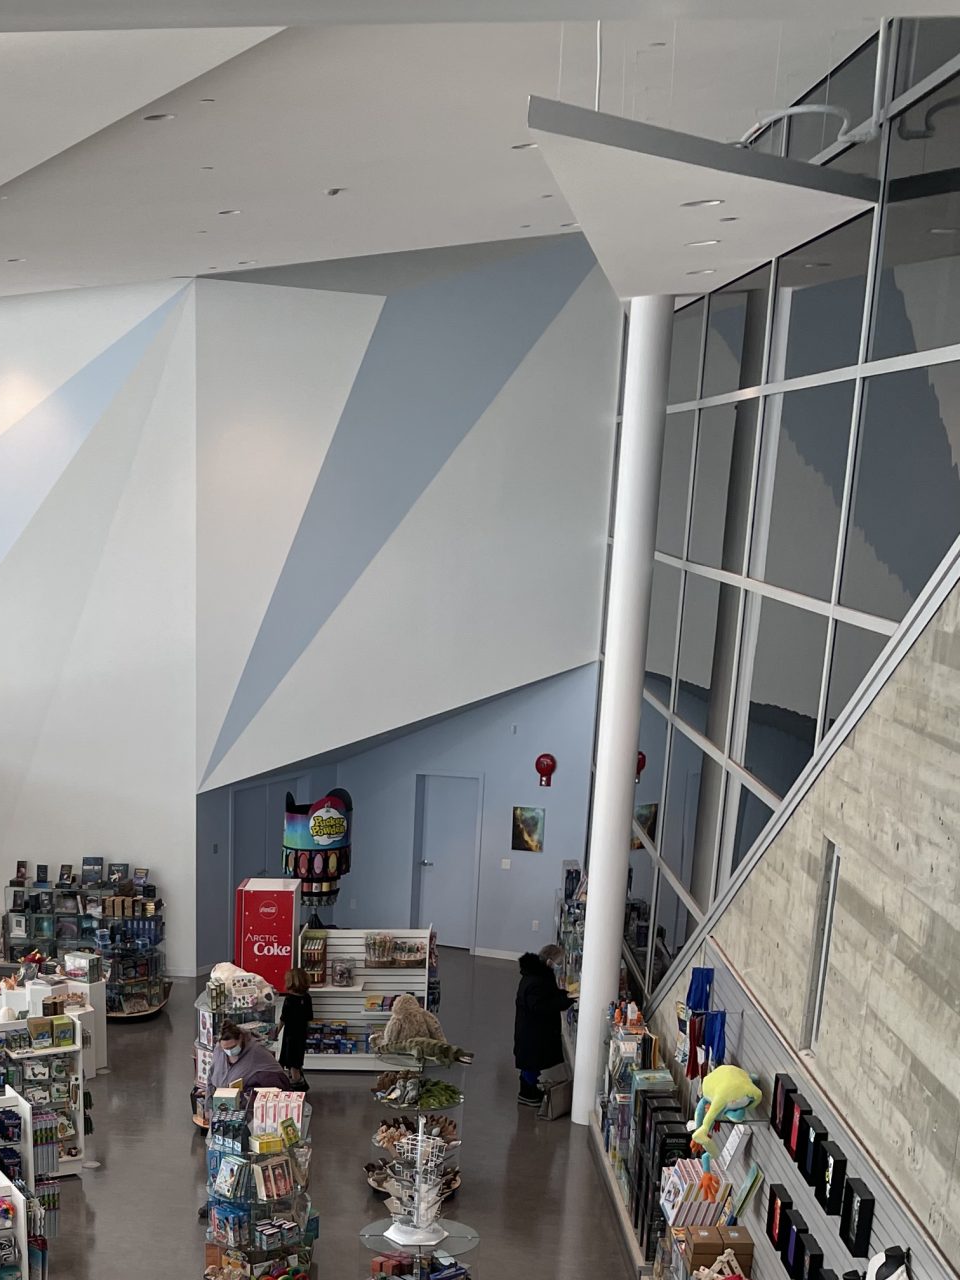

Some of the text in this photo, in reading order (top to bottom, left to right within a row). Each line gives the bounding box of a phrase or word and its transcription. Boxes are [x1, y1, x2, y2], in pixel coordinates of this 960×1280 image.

[313, 816, 344, 827] Pucker
[311, 826, 346, 837] Powder
[245, 933, 278, 942] ARCTIC
[253, 942, 291, 956] Coke
